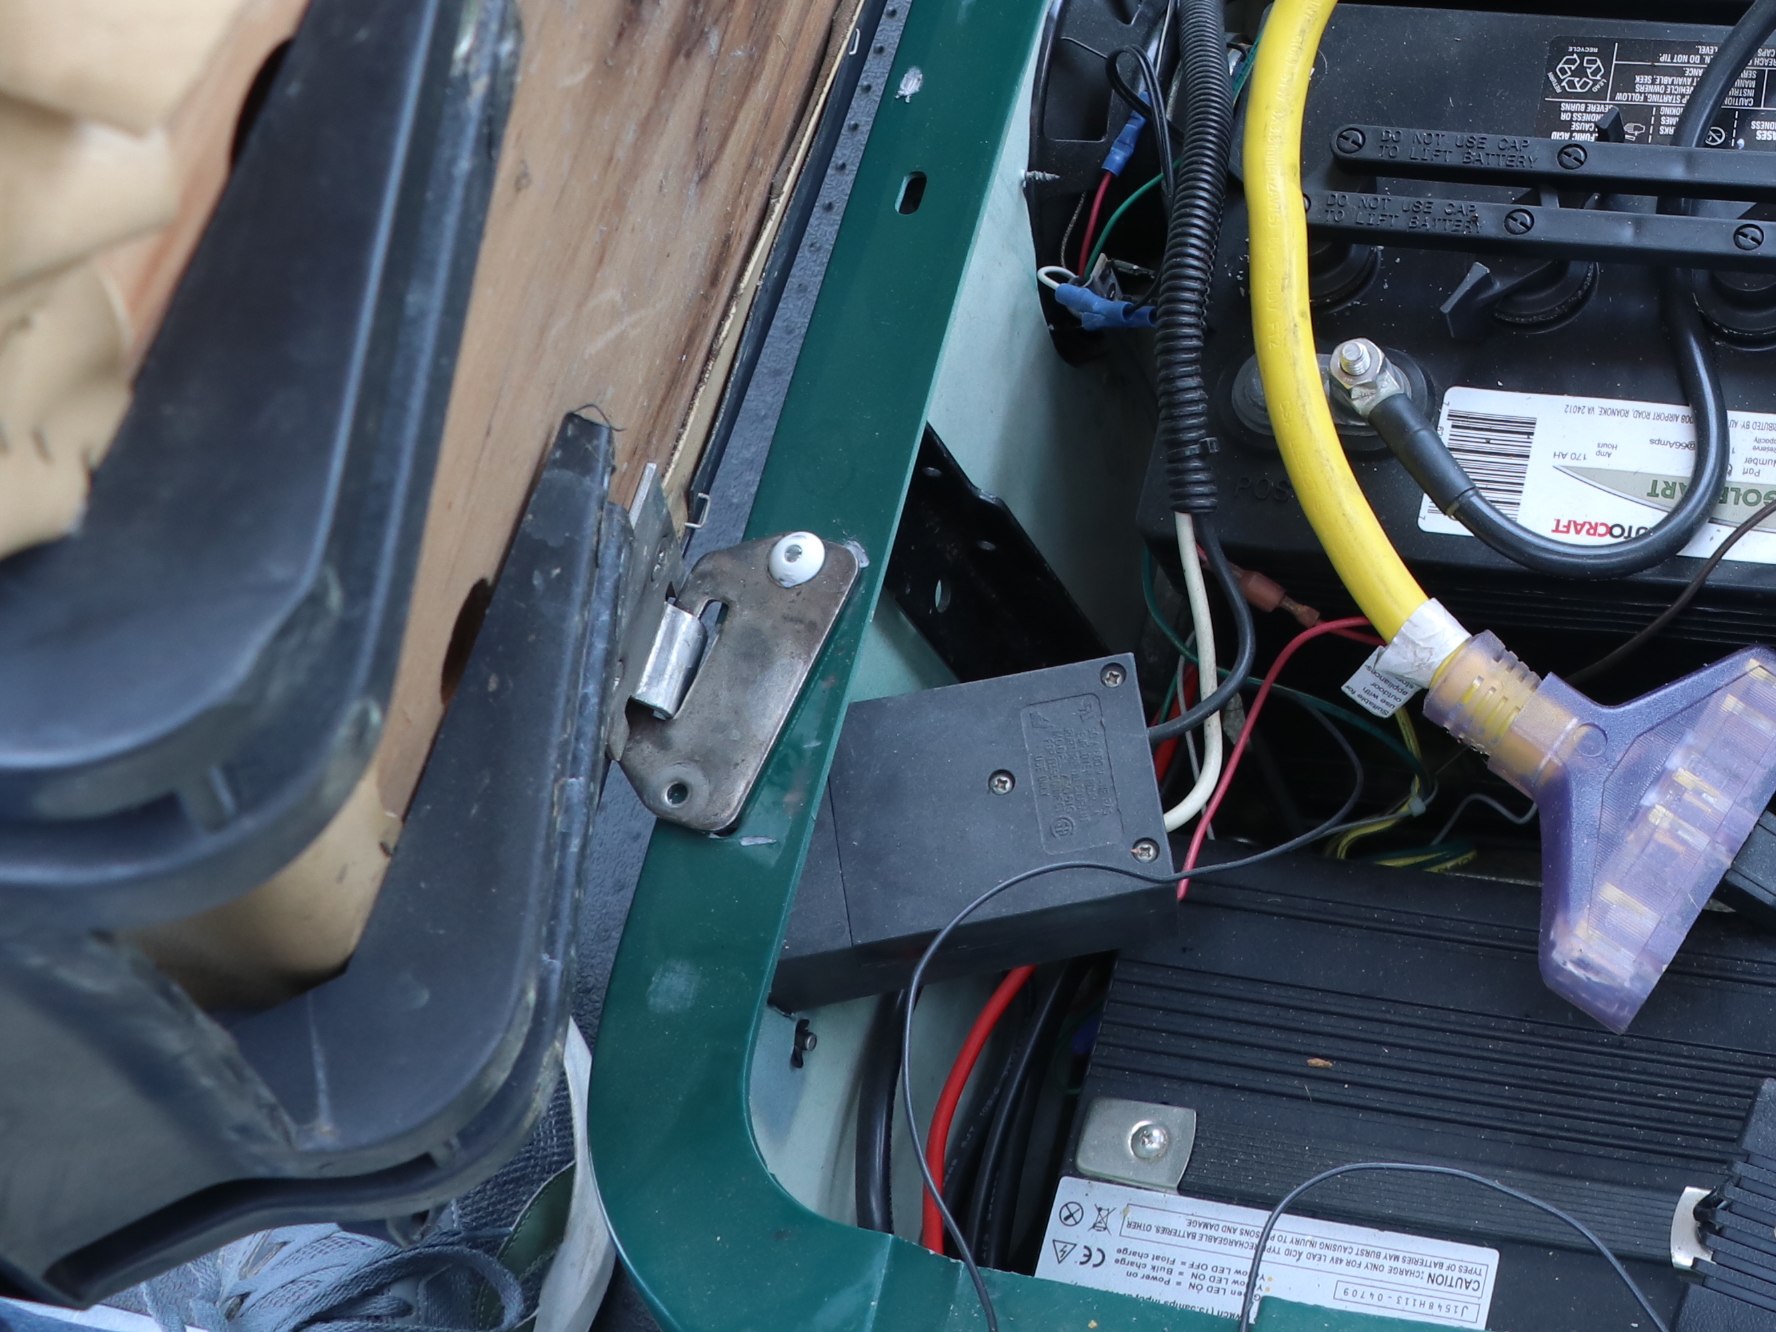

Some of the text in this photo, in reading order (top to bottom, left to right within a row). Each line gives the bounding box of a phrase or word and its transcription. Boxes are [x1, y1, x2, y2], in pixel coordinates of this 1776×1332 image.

[1551, 519, 1650, 539] UTOCRAFT
[1125, 1223, 1152, 1236] OTHER
[1184, 1219, 1219, 1234] DAMAGE.
[1220, 1225, 1239, 1238] AND
[1154, 1227, 1196, 1242] BATTERIES.
[1288, 1236, 1317, 1250] INJURY
[1318, 1241, 1353, 1256] CAUSING
[1305, 1250, 1327, 1263] LEAD
[1328, 1254, 1344, 1266] 48V
[1354, 1247, 1381, 1261] BURST
[1382, 1251, 1400, 1264] MAY
[1344, 1257, 1362, 1269] FOR
[1363, 1260, 1385, 1273] ONLY
[1400, 1254, 1444, 1271] BATTERIES
[1457, 1263, 1483, 1277] TYPES
[1426, 1273, 1480, 1293] CAUTION
